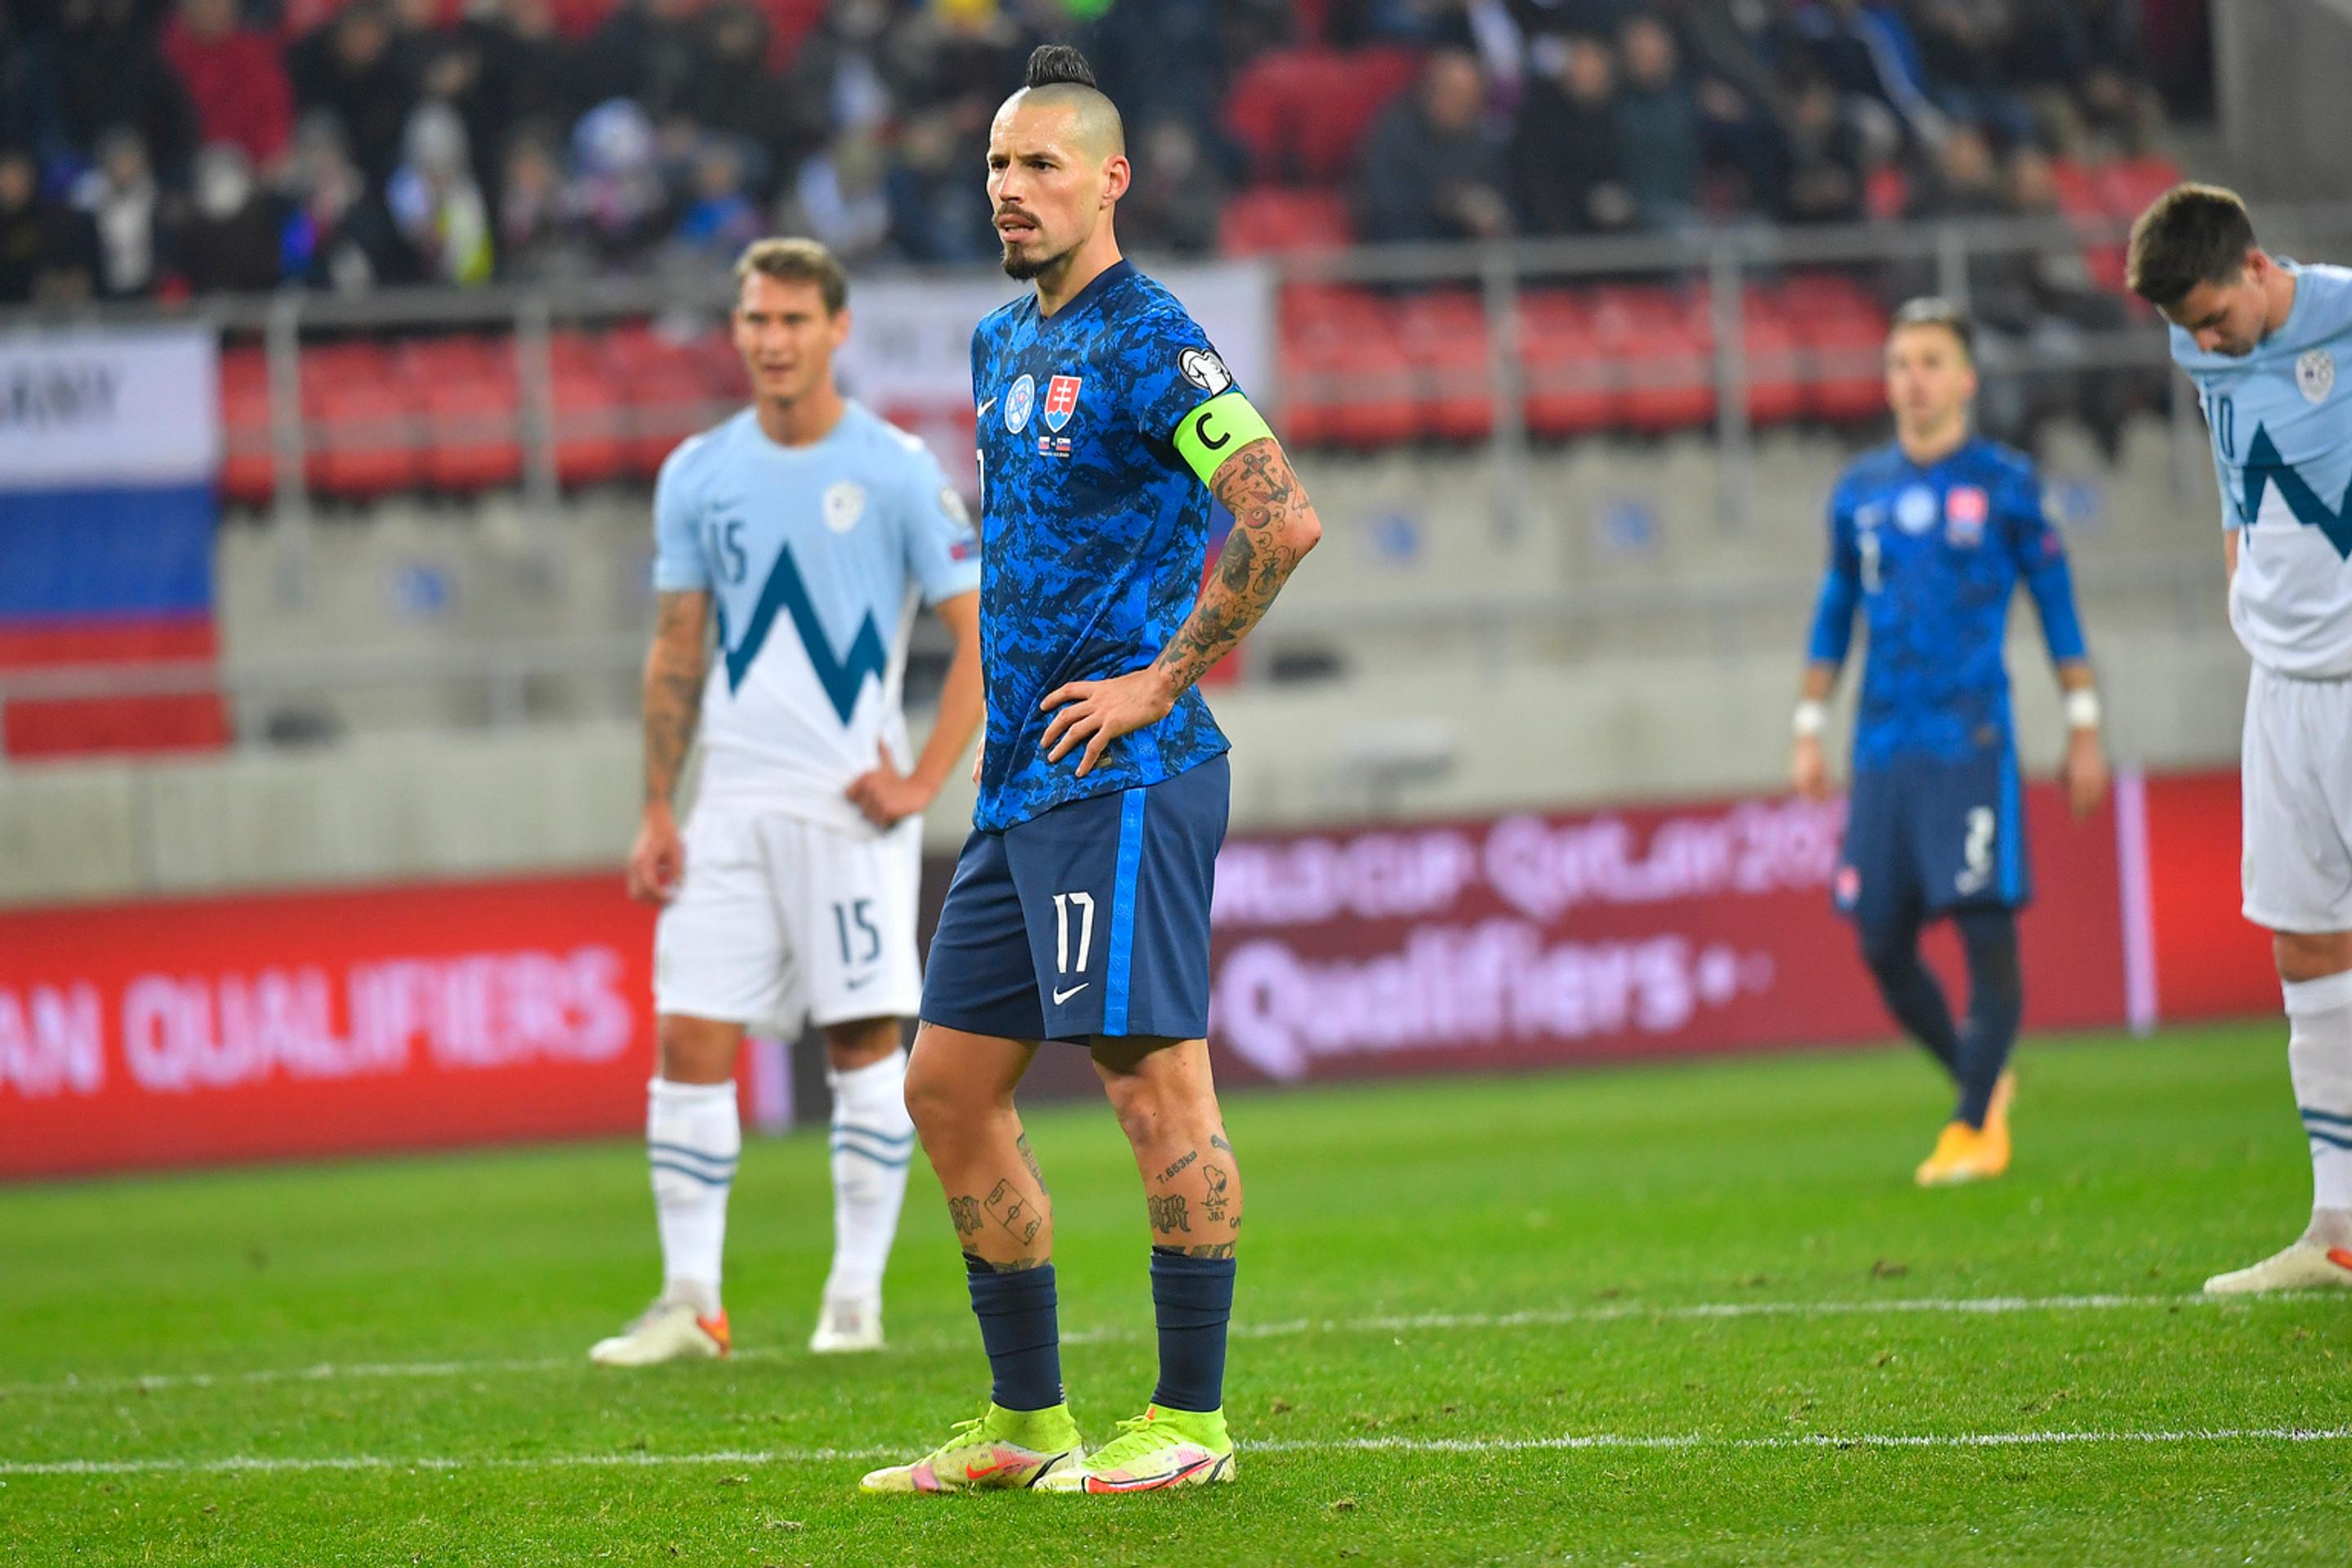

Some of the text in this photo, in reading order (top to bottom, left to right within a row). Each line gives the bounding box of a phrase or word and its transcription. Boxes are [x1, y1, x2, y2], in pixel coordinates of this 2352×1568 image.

[1196, 412, 1231, 450] C
[709, 521, 748, 586] 15
[831, 898, 882, 967] 15
[1053, 892, 1094, 973] 17
[122, 945, 633, 1094] QUALIFIERS
[1218, 921, 1695, 1080] Qualifiers
